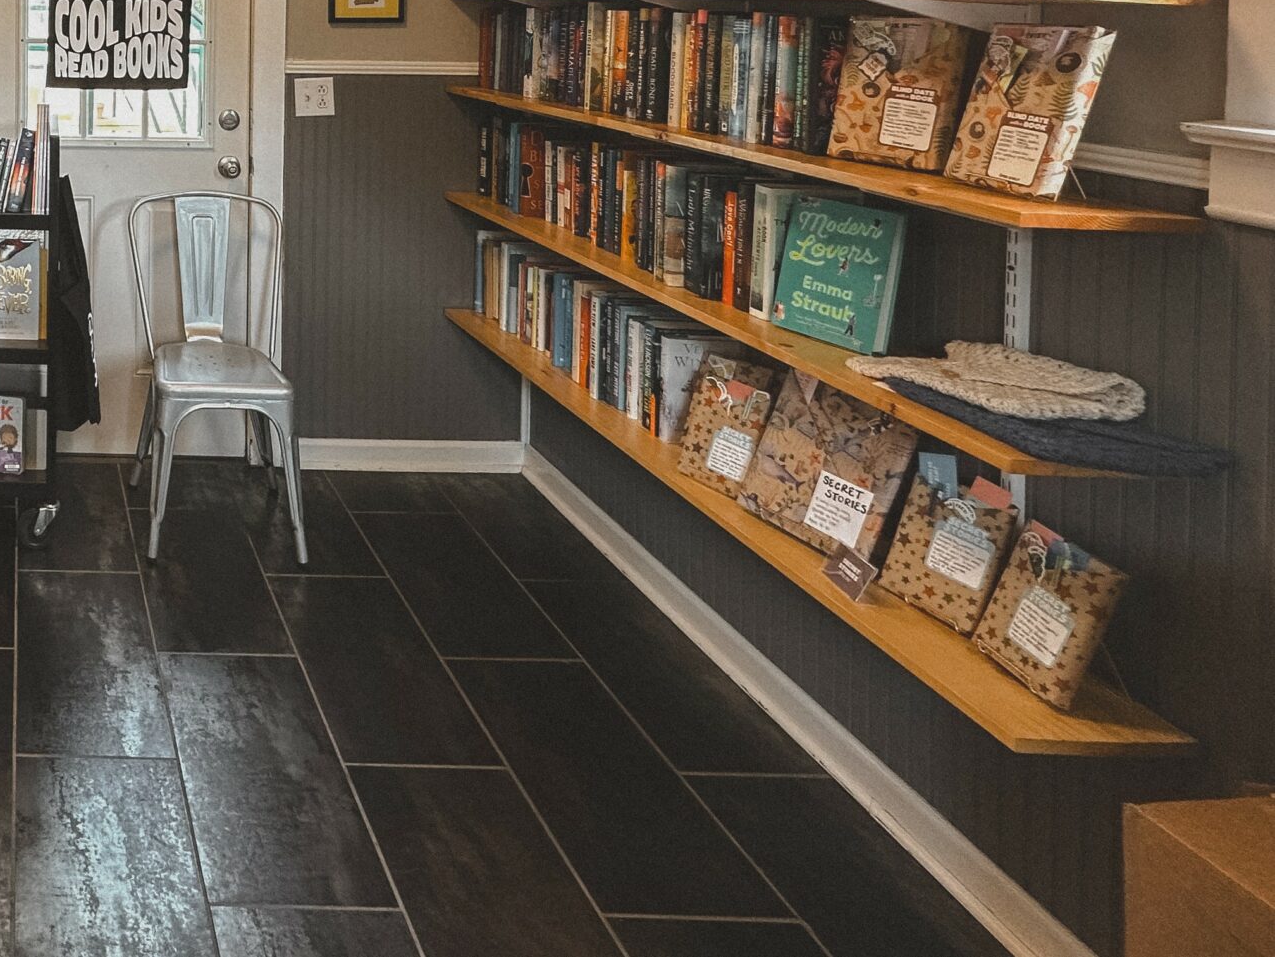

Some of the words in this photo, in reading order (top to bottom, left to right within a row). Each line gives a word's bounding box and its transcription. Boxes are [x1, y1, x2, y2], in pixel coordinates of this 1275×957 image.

[125, 0, 183, 39] KIDS
[55, 50, 109, 78] READ
[113, 32, 184, 80] BOOKS
[891, 85, 913, 94] BLIND
[913, 88, 936, 96] DATE
[909, 95, 934, 103] BOOK
[1007, 111, 1027, 120] BLIND
[1027, 115, 1050, 124] DATE
[1023, 121, 1047, 132] BOOK
[688, 188, 696, 216] Lady
[798, 211, 883, 239] Modern
[687, 219, 695, 270] Midnight
[789, 234, 879, 266] Lovers
[802, 275, 853, 302] Emma
[791, 291, 857, 323] Straub
[644, 346, 652, 378] JACKSON
[823, 475, 864, 499] SECRET
[825, 489, 867, 514] STORIES
